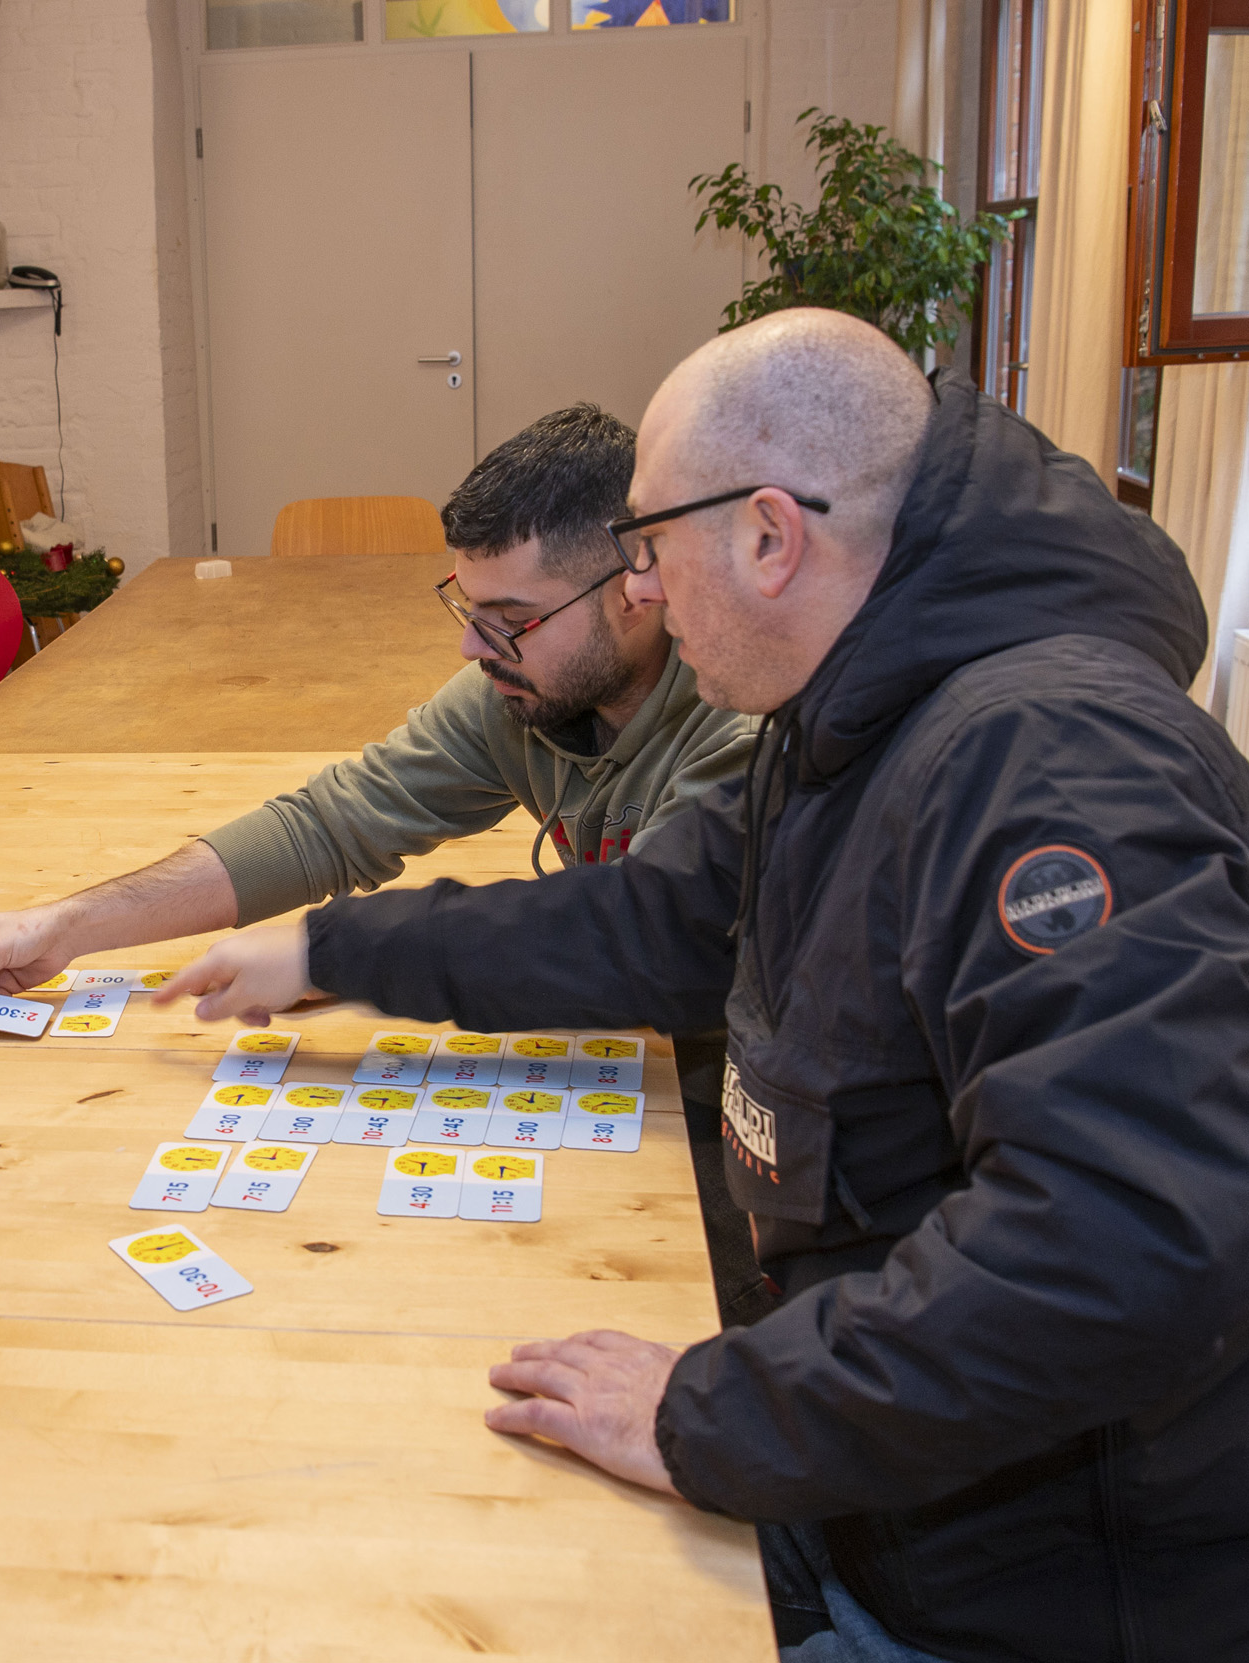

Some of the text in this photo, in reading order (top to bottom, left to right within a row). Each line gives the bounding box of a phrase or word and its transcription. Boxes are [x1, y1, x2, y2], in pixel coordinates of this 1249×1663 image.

[85, 976, 124, 984] 3:00
[84, 994, 105, 1008] 3:00
[240, 1060, 264, 1076] 11:15
[381, 1061, 405, 1079] 9:00
[454, 1060, 478, 1080] 12:30
[525, 1063, 547, 1083] 10:30
[598, 1066, 618, 1083] 8:30
[216, 1116, 241, 1133] 6:30
[289, 1117, 314, 1134] 1:00
[362, 1117, 389, 1140] 10:45
[441, 1118, 464, 1137] 6:45
[515, 1122, 538, 1141] 5:00
[592, 1123, 614, 1143] 8:30
[162, 1183, 188, 1201] 7:15
[243, 1183, 270, 1201] 7:15
[410, 1187, 432, 1209] 4:30
[492, 1191, 514, 1212] 11:15
[179, 1268, 222, 1297] 10:30
